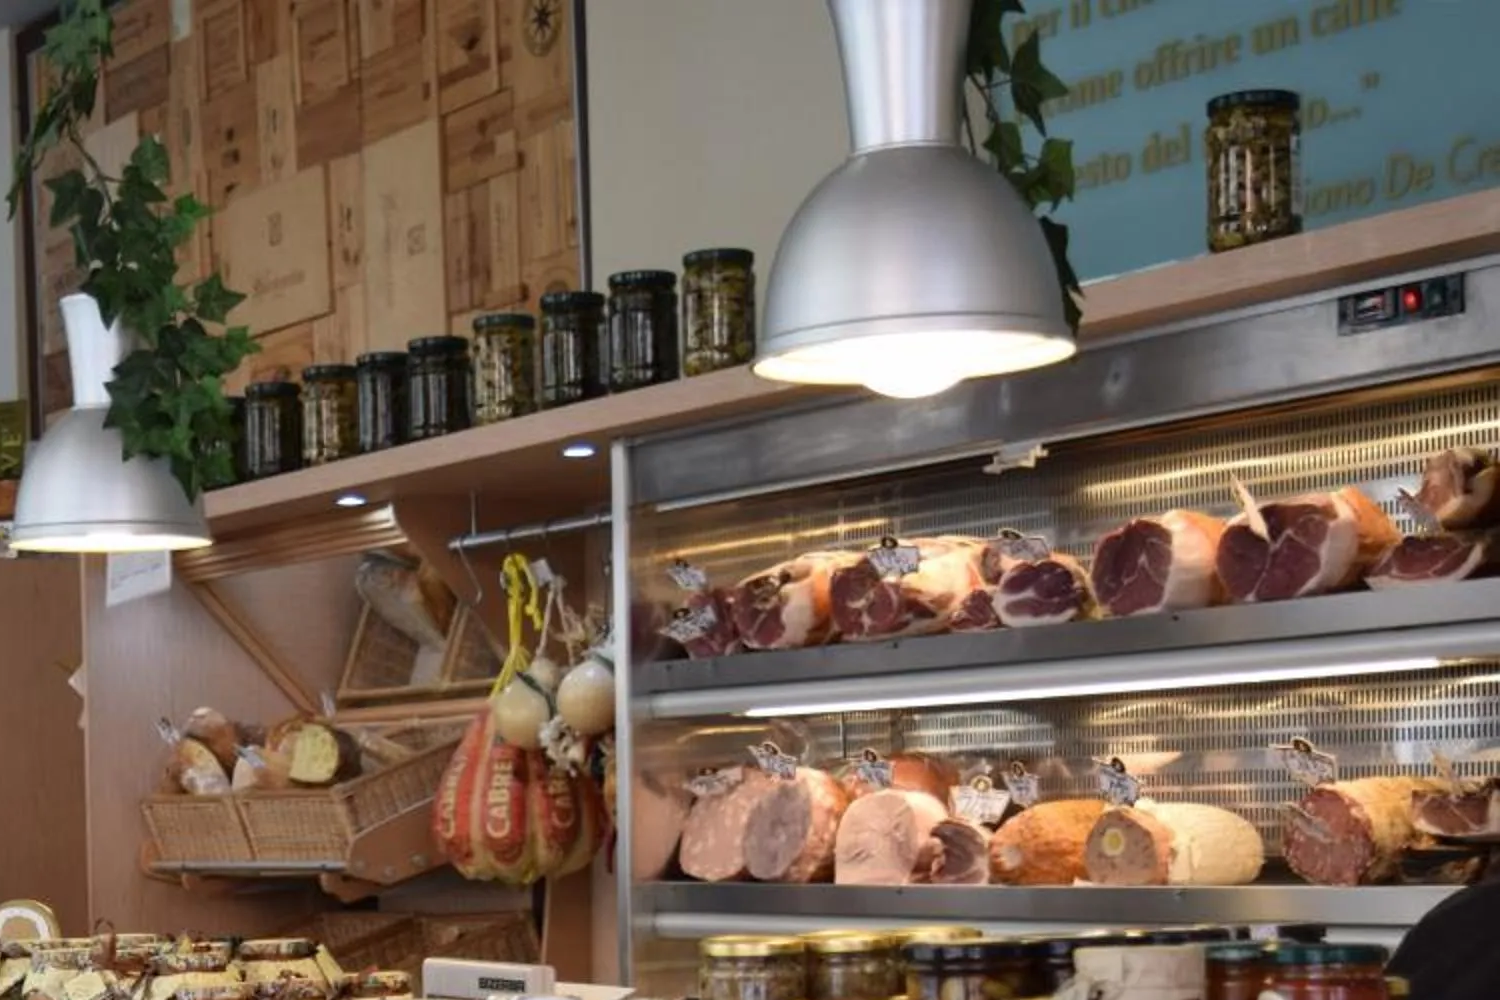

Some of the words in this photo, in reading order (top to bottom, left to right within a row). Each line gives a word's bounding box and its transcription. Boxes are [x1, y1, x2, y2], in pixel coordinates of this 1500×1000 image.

[1134, 32, 1241, 91] offrire
[1253, 14, 1299, 55] un
[1141, 121, 1192, 174] del
[1383, 151, 1435, 199] De
